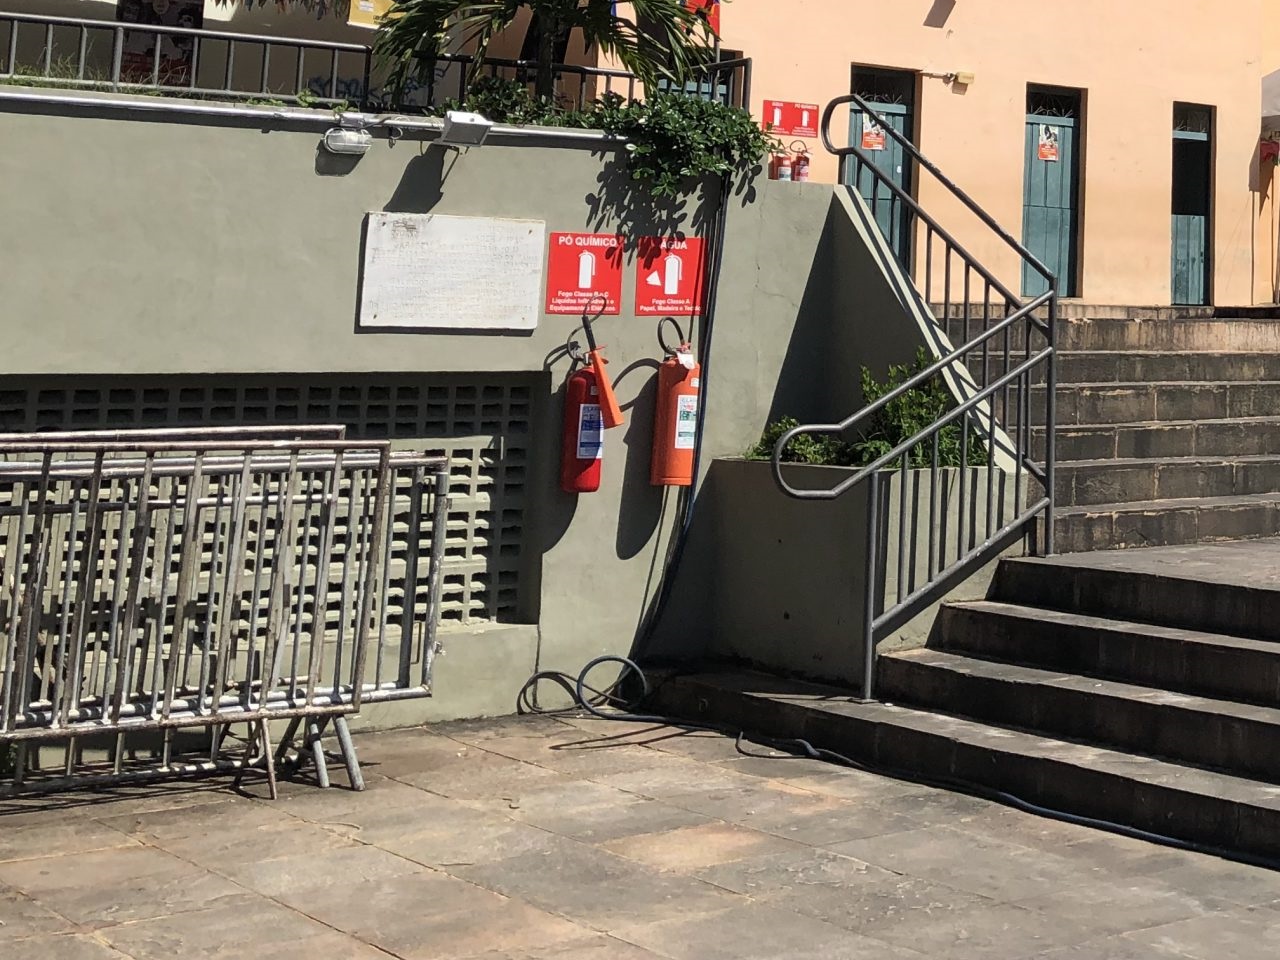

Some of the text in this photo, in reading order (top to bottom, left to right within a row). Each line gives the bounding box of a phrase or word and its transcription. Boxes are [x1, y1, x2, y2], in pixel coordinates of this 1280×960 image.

[558, 234, 617, 247] PÓ QUÍMICO
[660, 238, 688, 250] ÁGUA
[557, 290, 573, 298] Fogo
